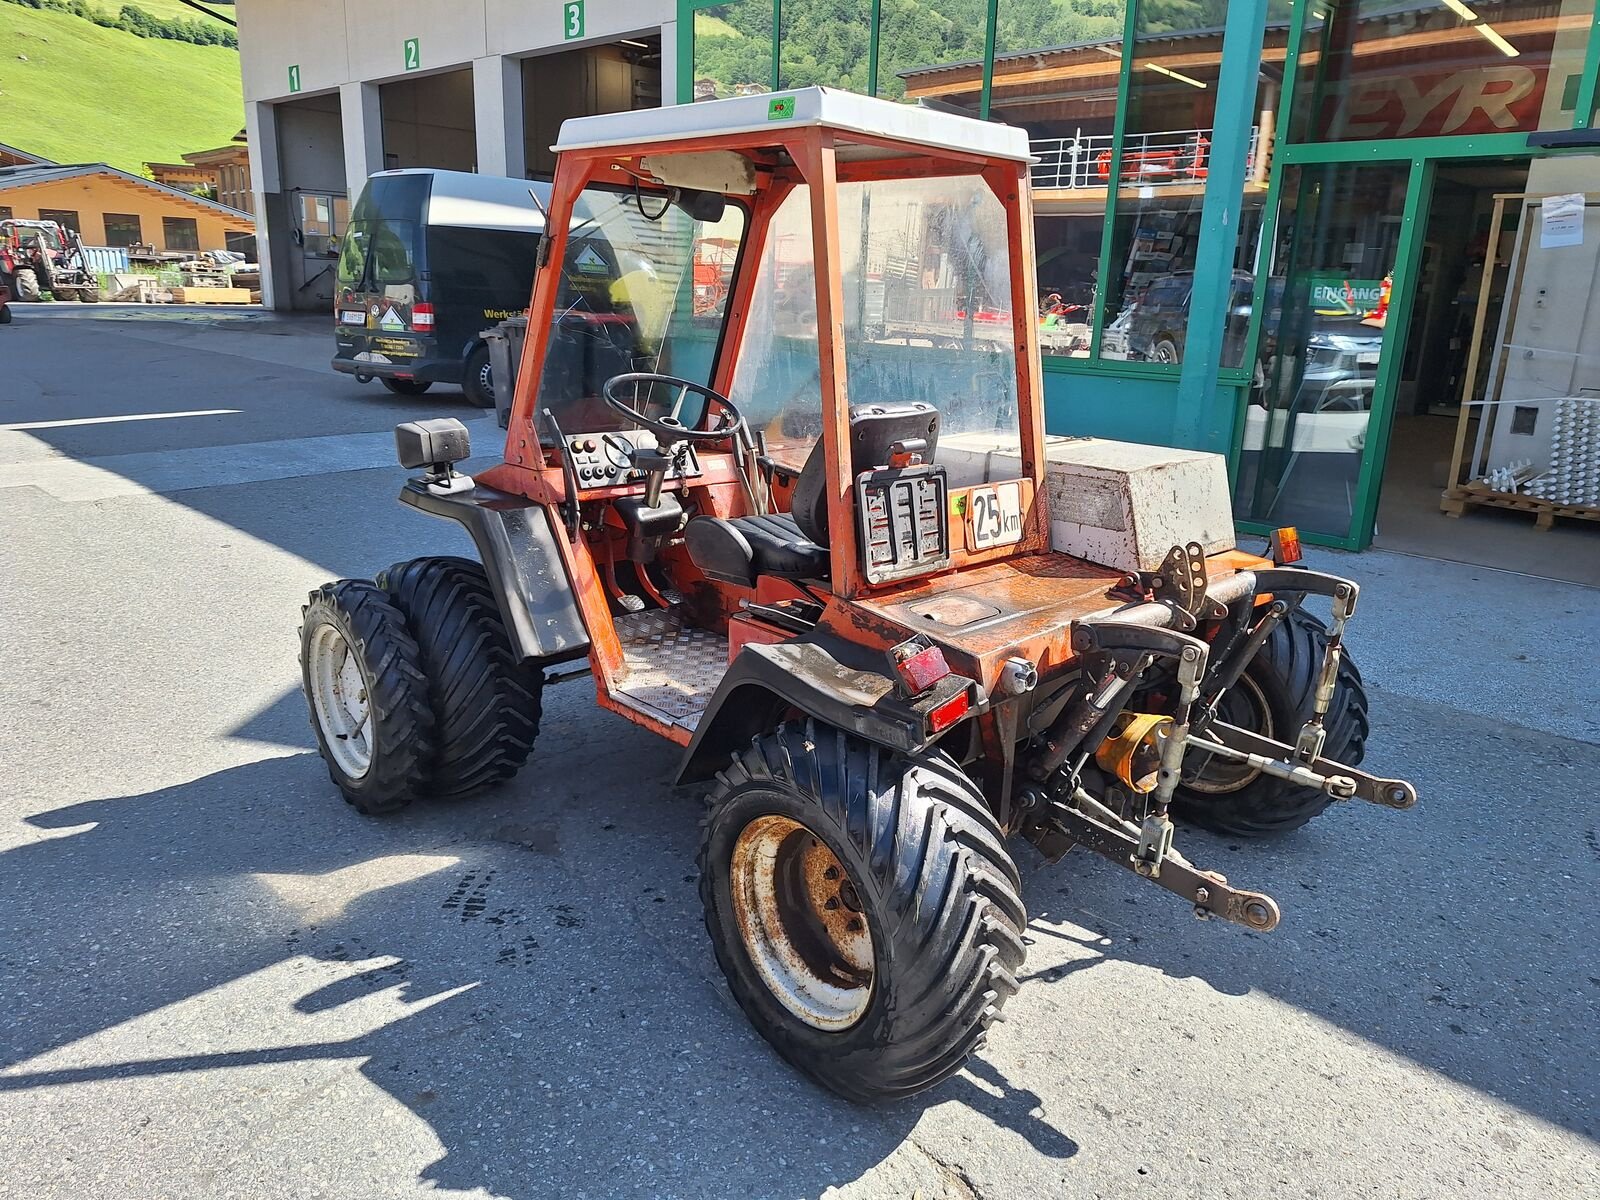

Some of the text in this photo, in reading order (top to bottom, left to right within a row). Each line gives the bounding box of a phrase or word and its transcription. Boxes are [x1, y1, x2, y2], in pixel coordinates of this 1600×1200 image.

[568, 4, 580, 37] 3
[407, 41, 417, 68] 2
[290, 67, 299, 90] 1
[1313, 286, 1380, 300] EINGANG
[974, 494, 1019, 541] 25 km
